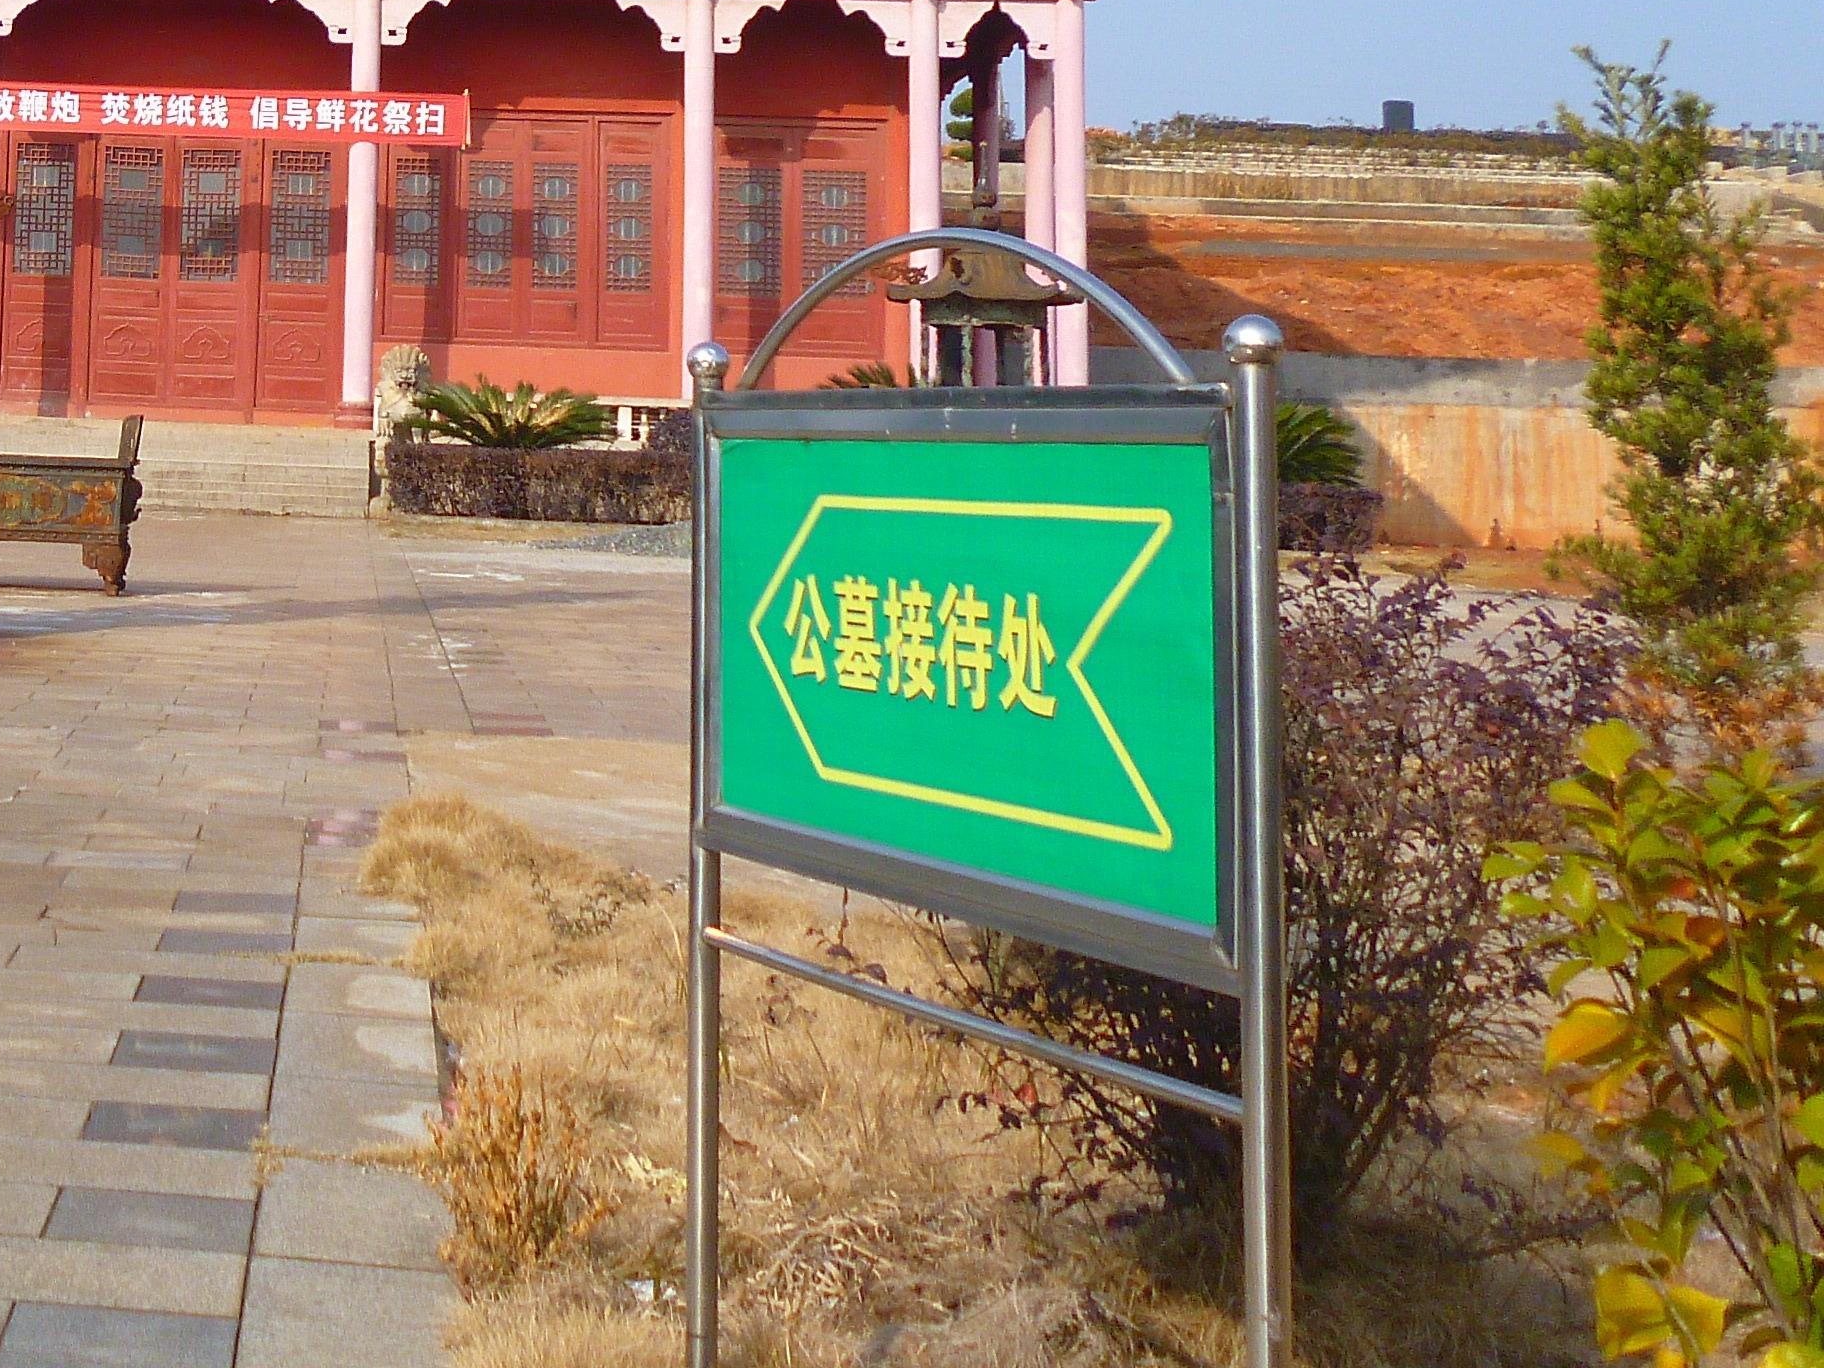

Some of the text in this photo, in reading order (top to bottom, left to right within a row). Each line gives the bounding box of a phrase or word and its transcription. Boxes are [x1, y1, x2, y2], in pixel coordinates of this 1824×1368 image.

[101, 93, 229, 129] 焚烧纸钱
[249, 96, 445, 135] 倡导鲜花祭扫
[783, 574, 1057, 718] 公墓接待处
